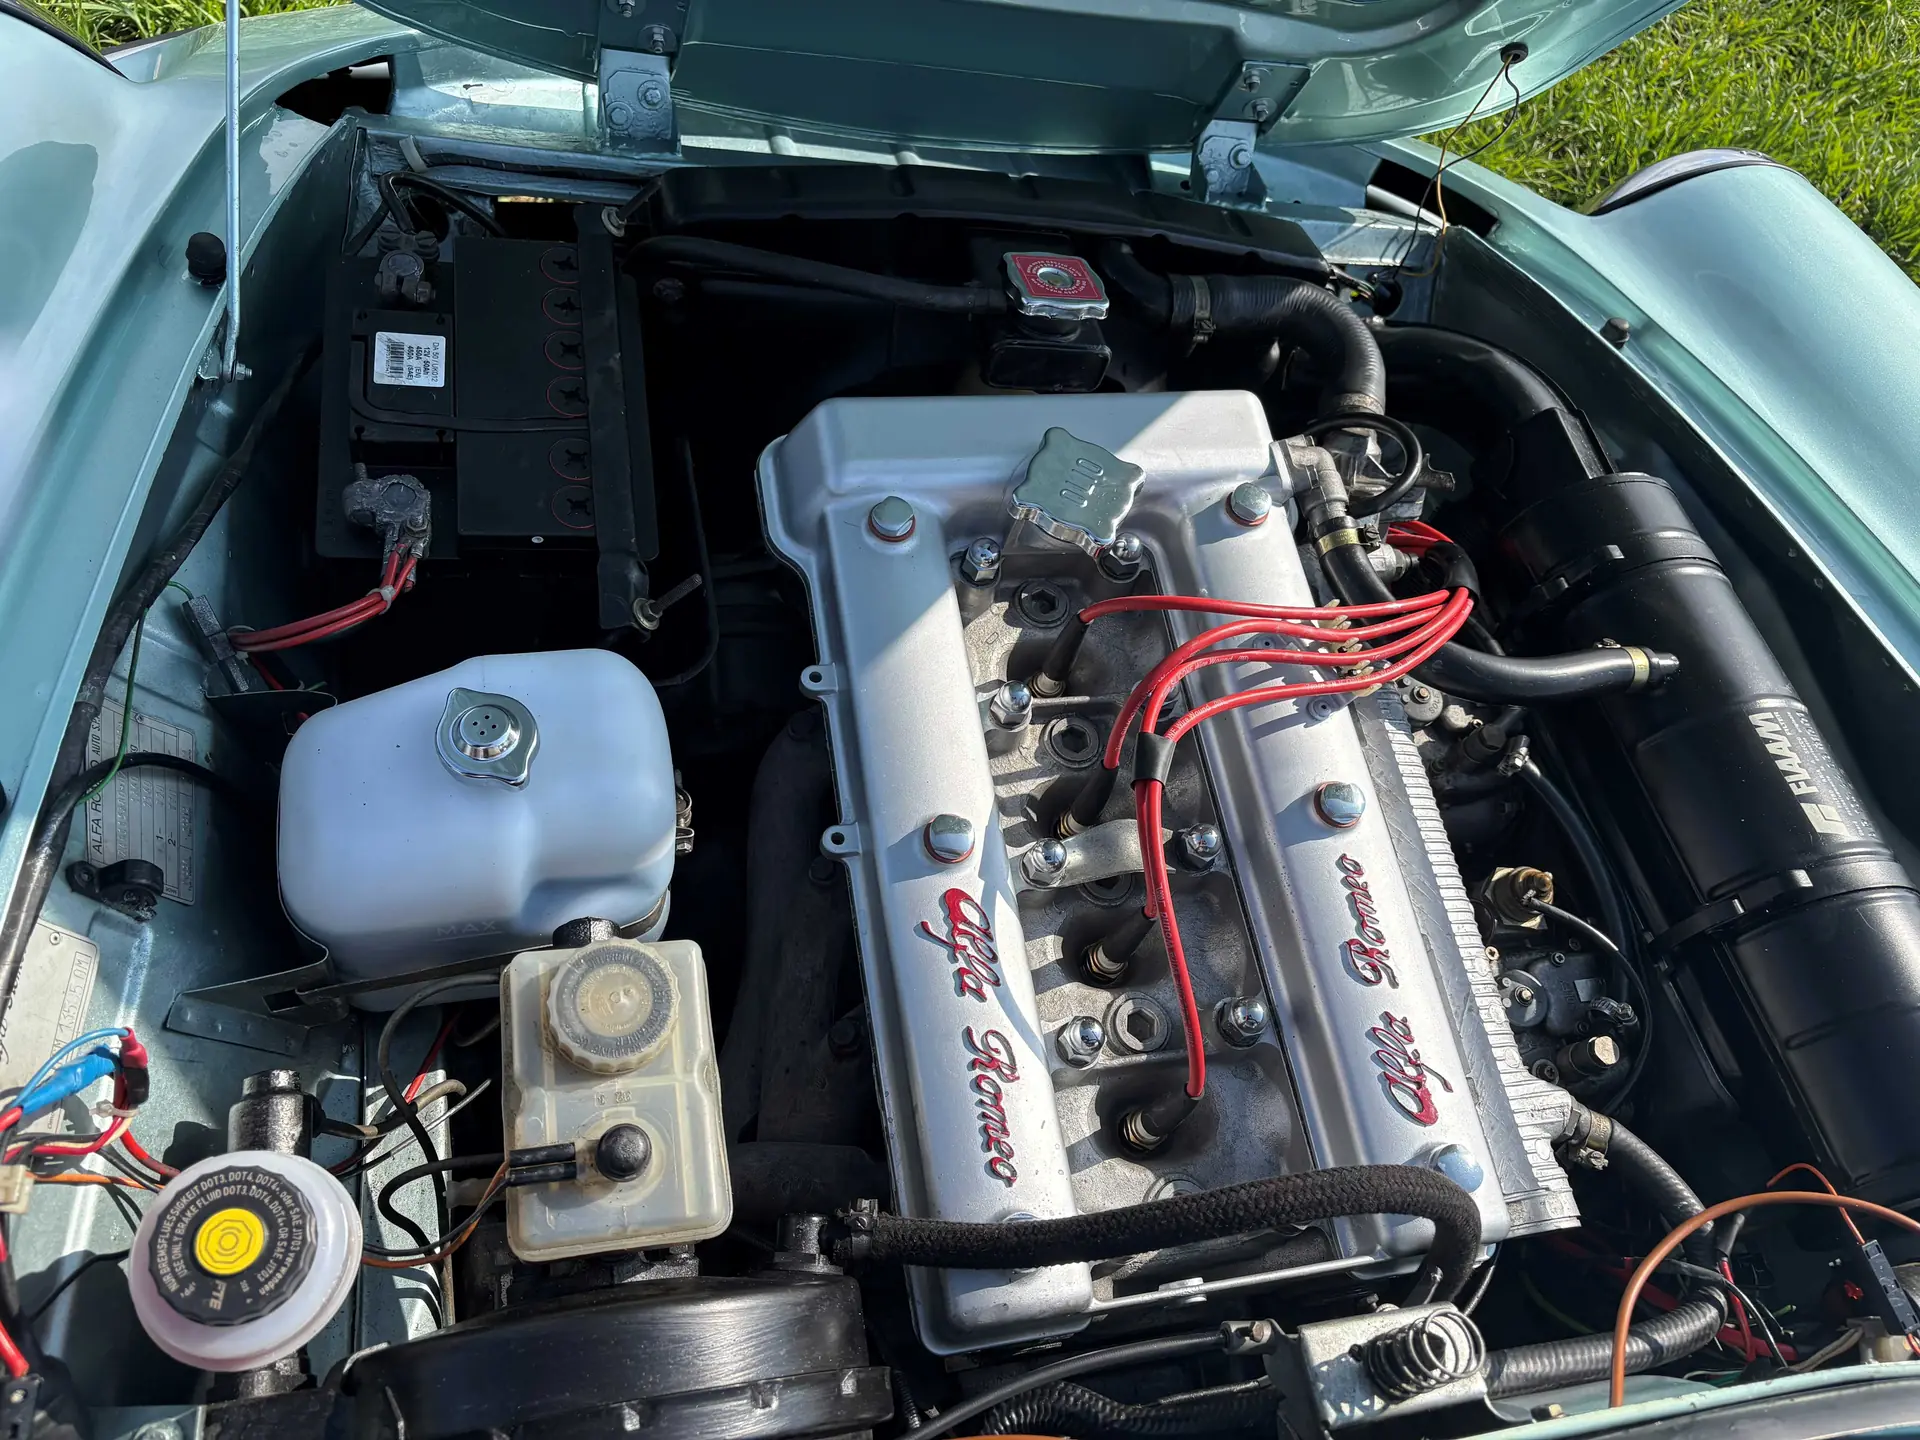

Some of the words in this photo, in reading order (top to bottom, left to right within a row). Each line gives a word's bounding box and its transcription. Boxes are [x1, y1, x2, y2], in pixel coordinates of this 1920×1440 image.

[1060, 457, 1104, 508] OLIO
[1188, 703, 1211, 721] Wound
[1773, 711, 1795, 736] FILTER
[90, 735, 101, 756] AUTO
[1748, 712, 1819, 796] FIAAM
[91, 818, 102, 855] ALFA
[435, 921, 498, 936] MAX
[1159, 911, 1175, 949] Wound
[1335, 853, 1399, 989] Romeo
[920, 888, 1002, 1003] Alfa
[966, 1026, 1021, 1187] Romeo
[1365, 1011, 1453, 1127] Alfa
[197, 1189, 222, 1210] FLUID
[279, 1191, 295, 1208] oder
[176, 1206, 200, 1236] BRAKE
[289, 1207, 302, 1227] SAE
[156, 1185, 200, 1277] BREMSFLUESSIGKEIT
[276, 1226, 288, 1240] OR
[171, 1234, 183, 1261] ONLY
[273, 1240, 287, 1260] SAE
[172, 1259, 189, 1278] USE
[258, 1251, 296, 1297] verwenden
[164, 1274, 180, 1293] NUR
[208, 1279, 228, 1312] FTE
